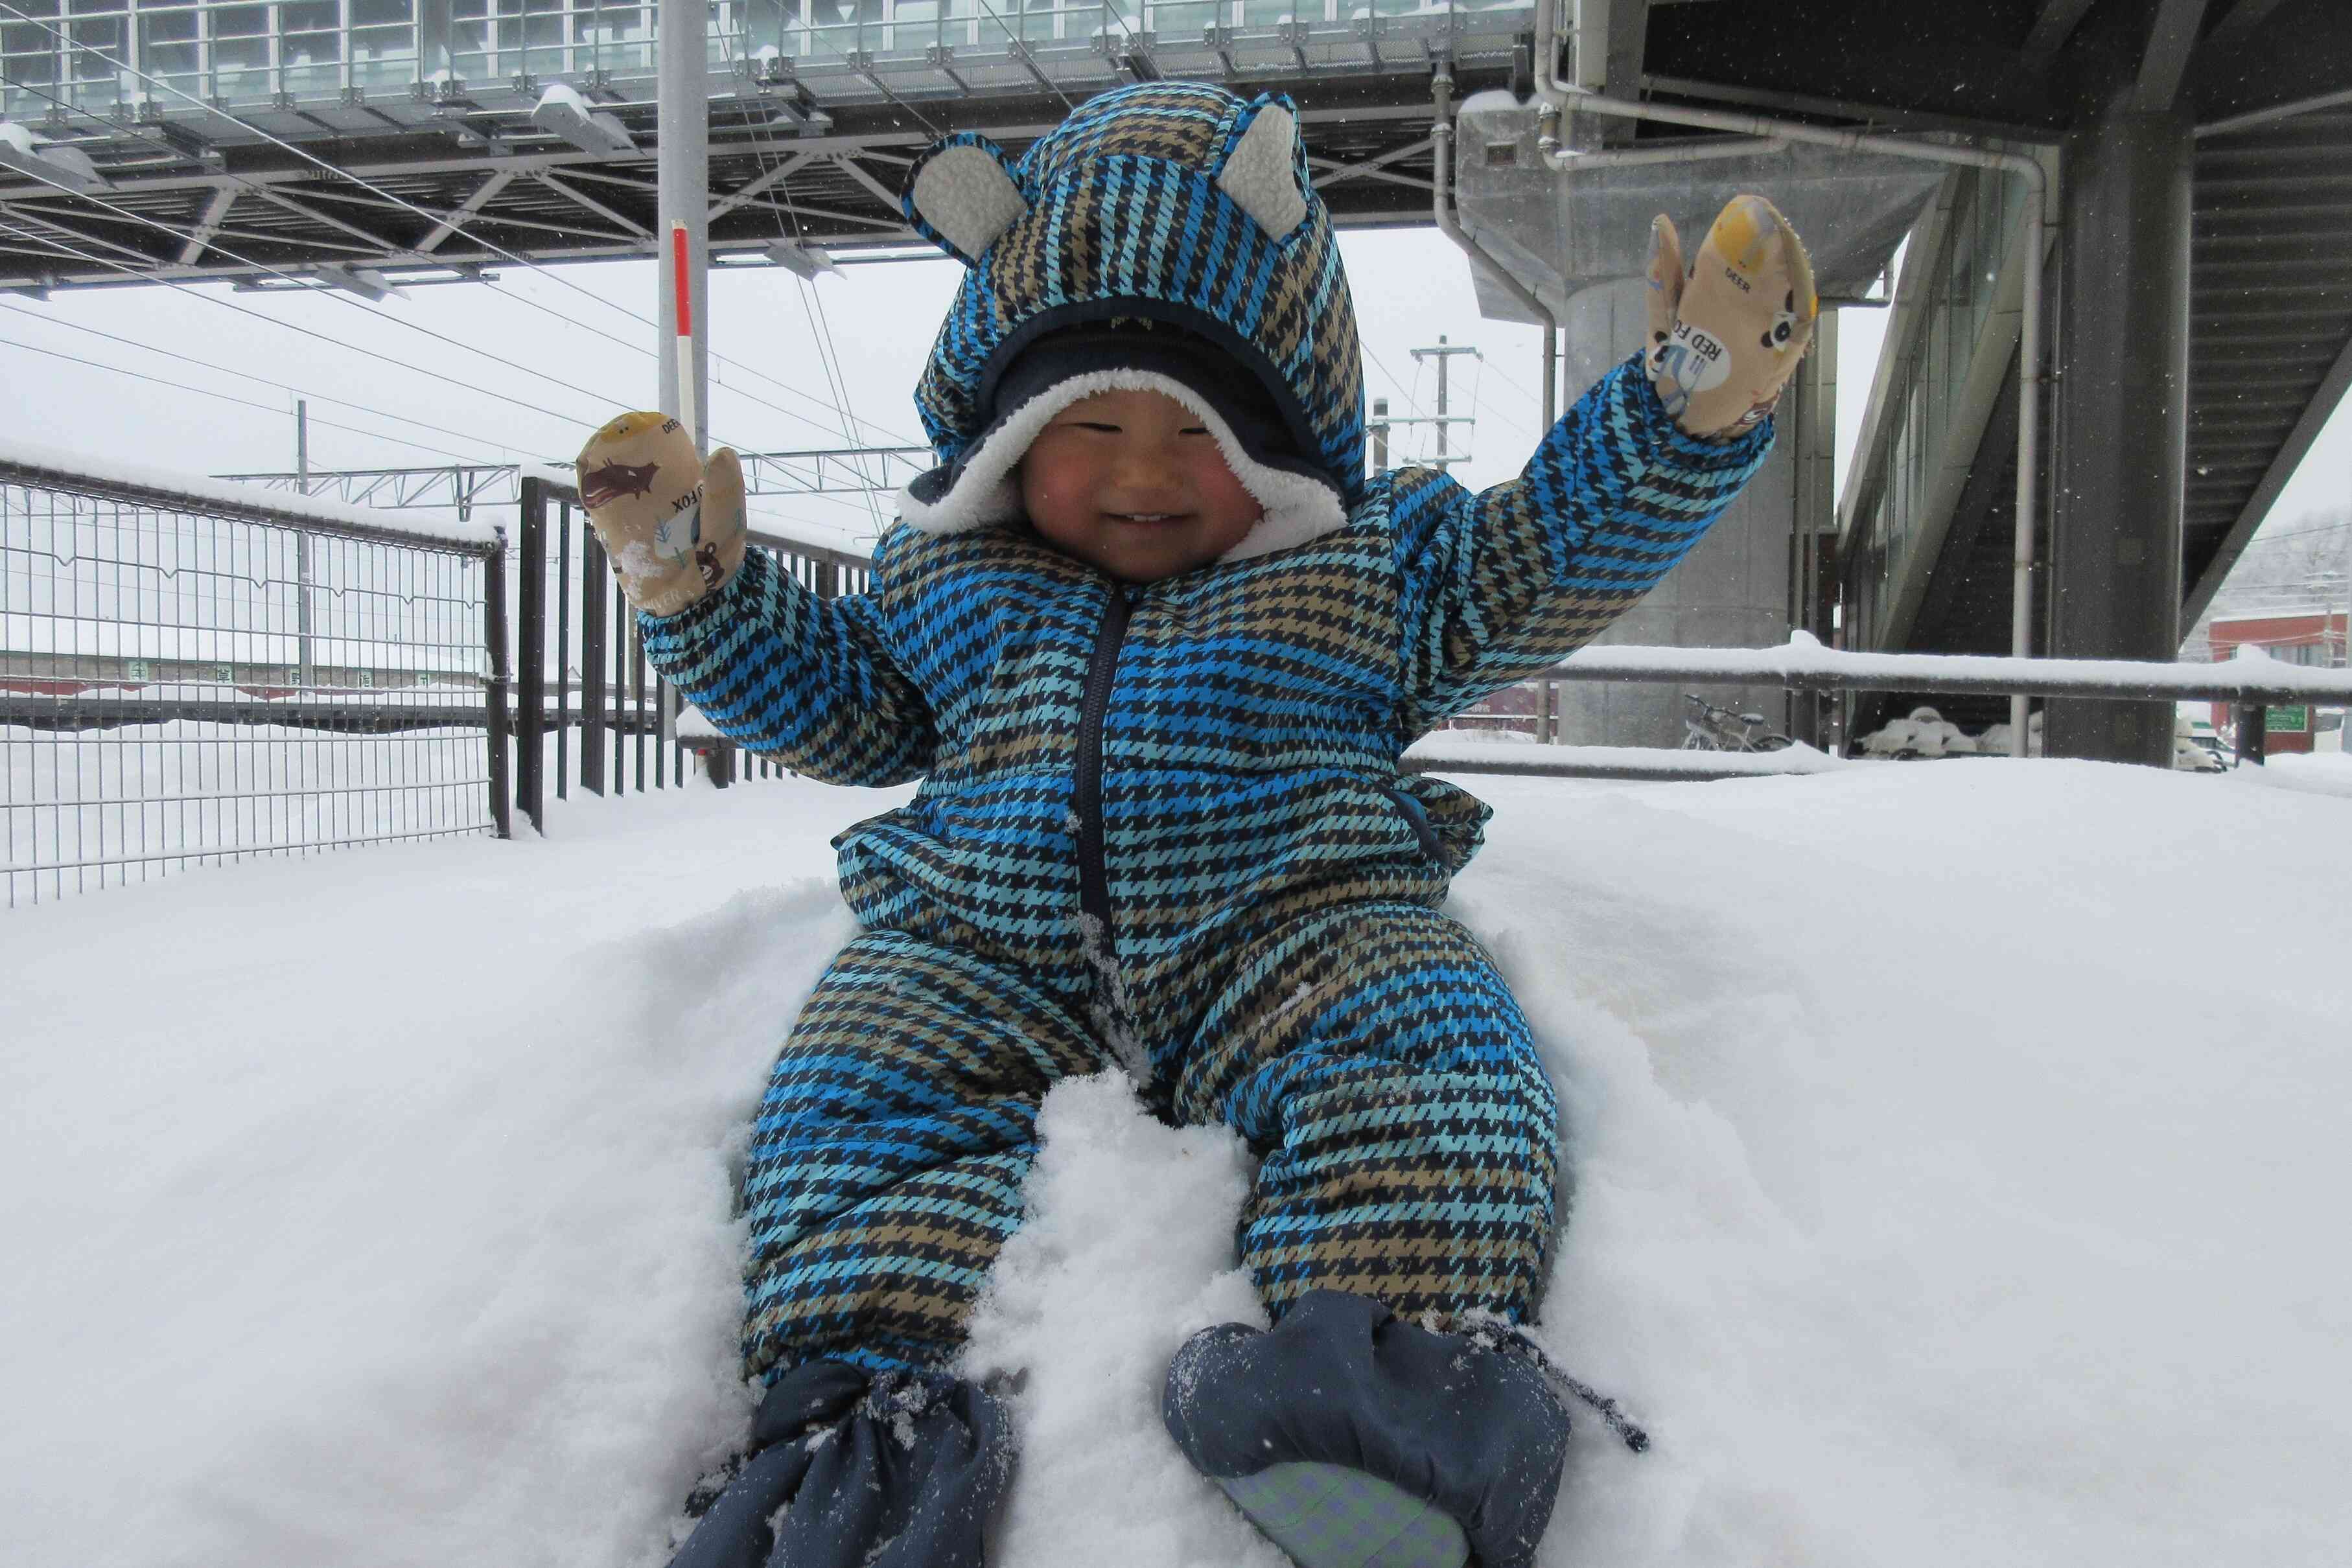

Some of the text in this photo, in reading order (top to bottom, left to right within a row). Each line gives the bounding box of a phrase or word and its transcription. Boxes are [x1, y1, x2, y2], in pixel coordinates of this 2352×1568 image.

[1673, 319, 1722, 362] RED FO
[671, 490, 698, 514] FOX
